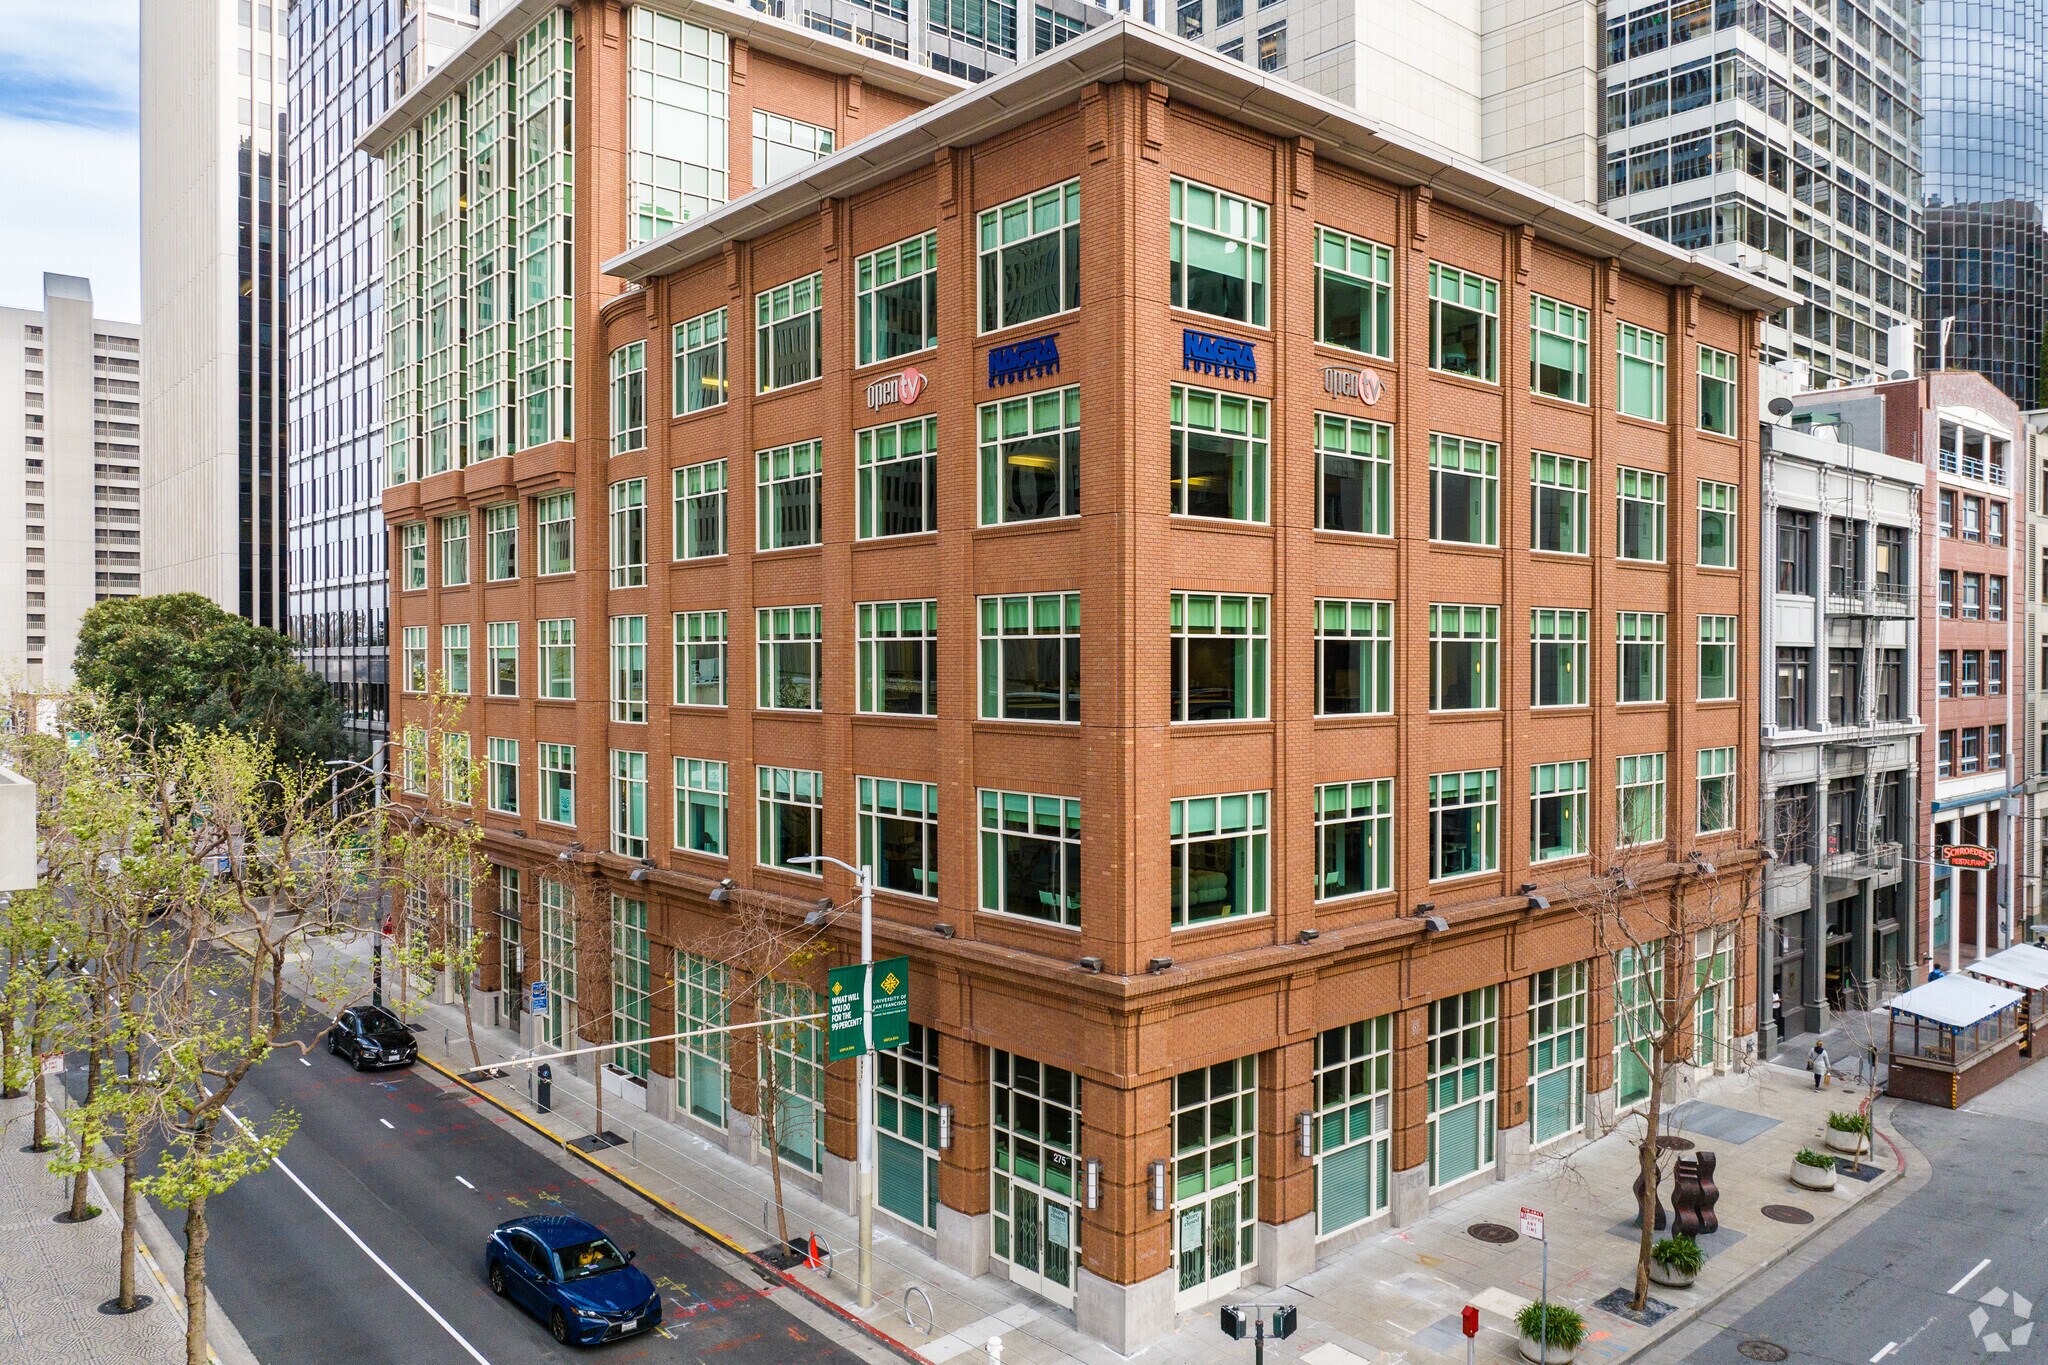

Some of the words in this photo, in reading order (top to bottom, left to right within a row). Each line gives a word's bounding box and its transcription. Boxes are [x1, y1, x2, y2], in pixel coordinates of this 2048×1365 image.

[989, 337, 1059, 374] NAGRA
[1184, 331, 1256, 369] NAGRA
[988, 360, 1060, 389] KUDELSKI
[1184, 358, 1257, 384] KUDELSKI
[1951, 857, 1987, 867] RESTAURANT
[831, 995, 847, 1005] WHAT
[847, 992, 860, 1002] WILL
[873, 995, 900, 1004] UNIVERSITY
[882, 1000, 907, 1009] FRANCISCO
[831, 1004, 843, 1014] YOU
[843, 1003, 851, 1012] DO
[831, 1013, 842, 1023] FOR
[842, 1011, 852, 1020] THE
[831, 1022, 839, 1031] 99
[839, 1017, 863, 1030] PERCENT?
[1053, 1153, 1066, 1166] 275
[1526, 1220, 1537, 1228] ANY
[1526, 1226, 1537, 1234] TIME
